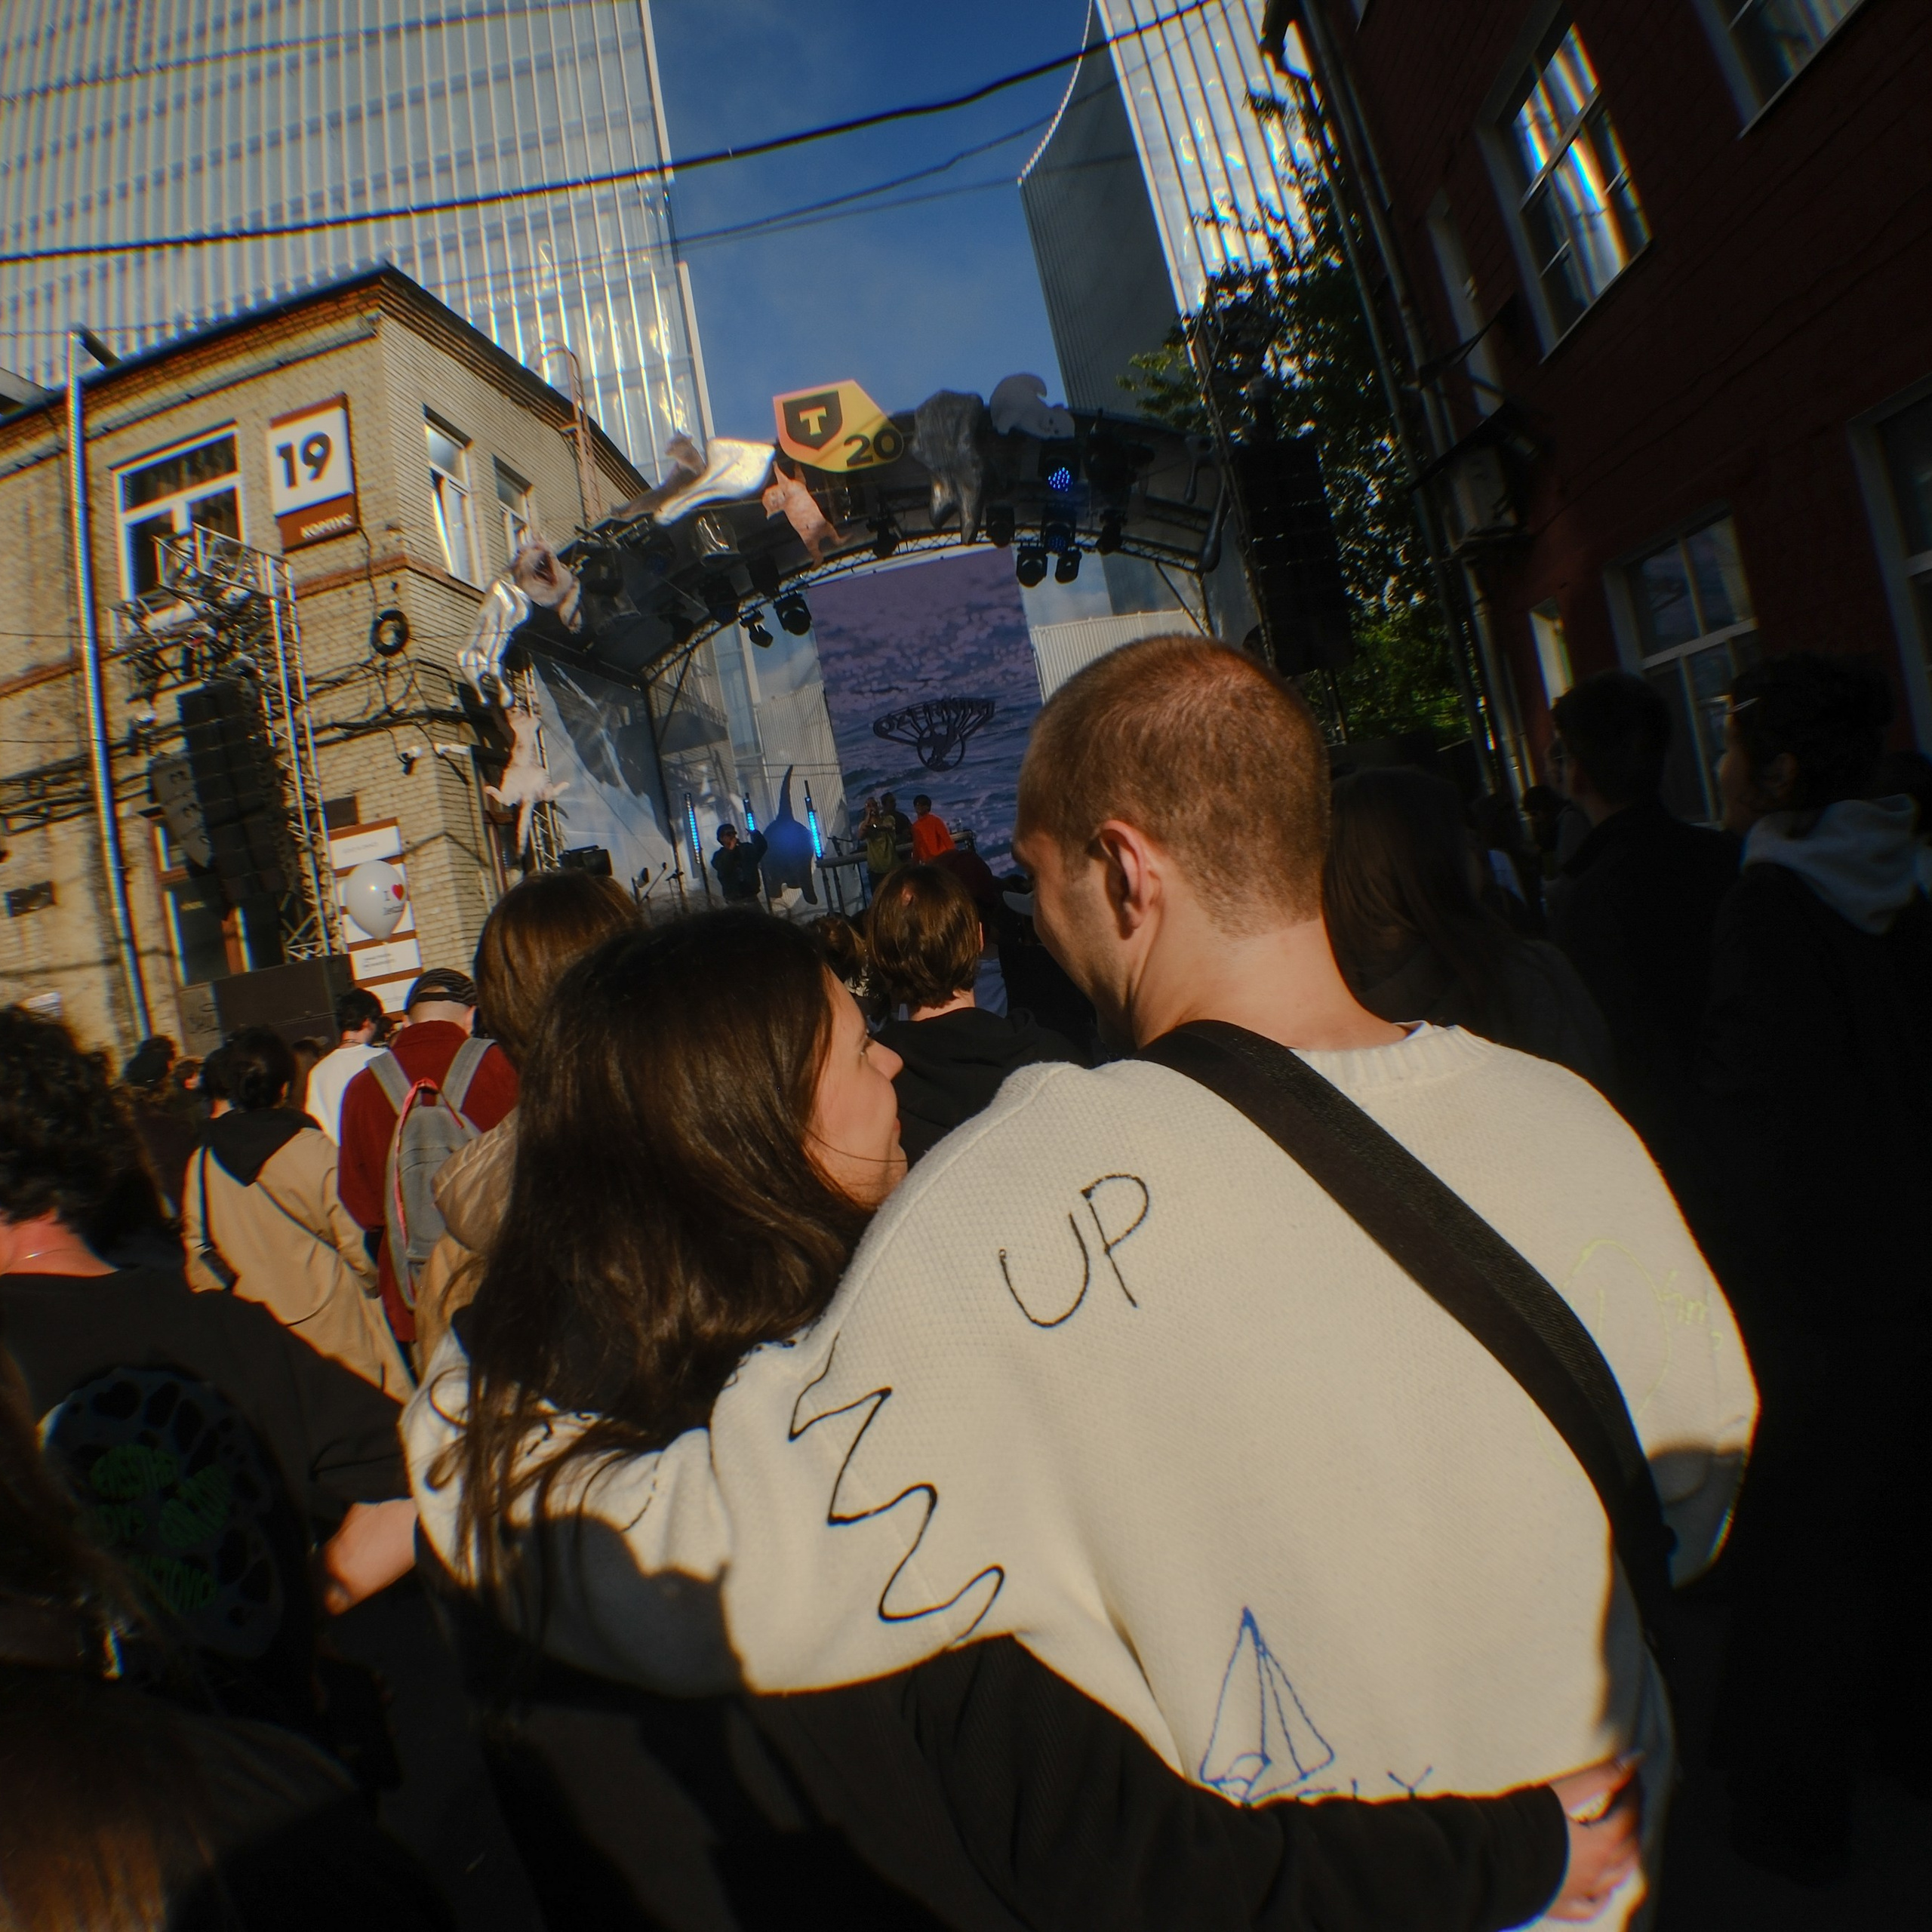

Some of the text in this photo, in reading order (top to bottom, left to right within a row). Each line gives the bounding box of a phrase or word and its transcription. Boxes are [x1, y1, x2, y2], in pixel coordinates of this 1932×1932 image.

[799, 406, 827, 435] T
[276, 431, 332, 488] 19
[844, 429, 900, 467] 20
[998, 1173, 1149, 1327] UP
